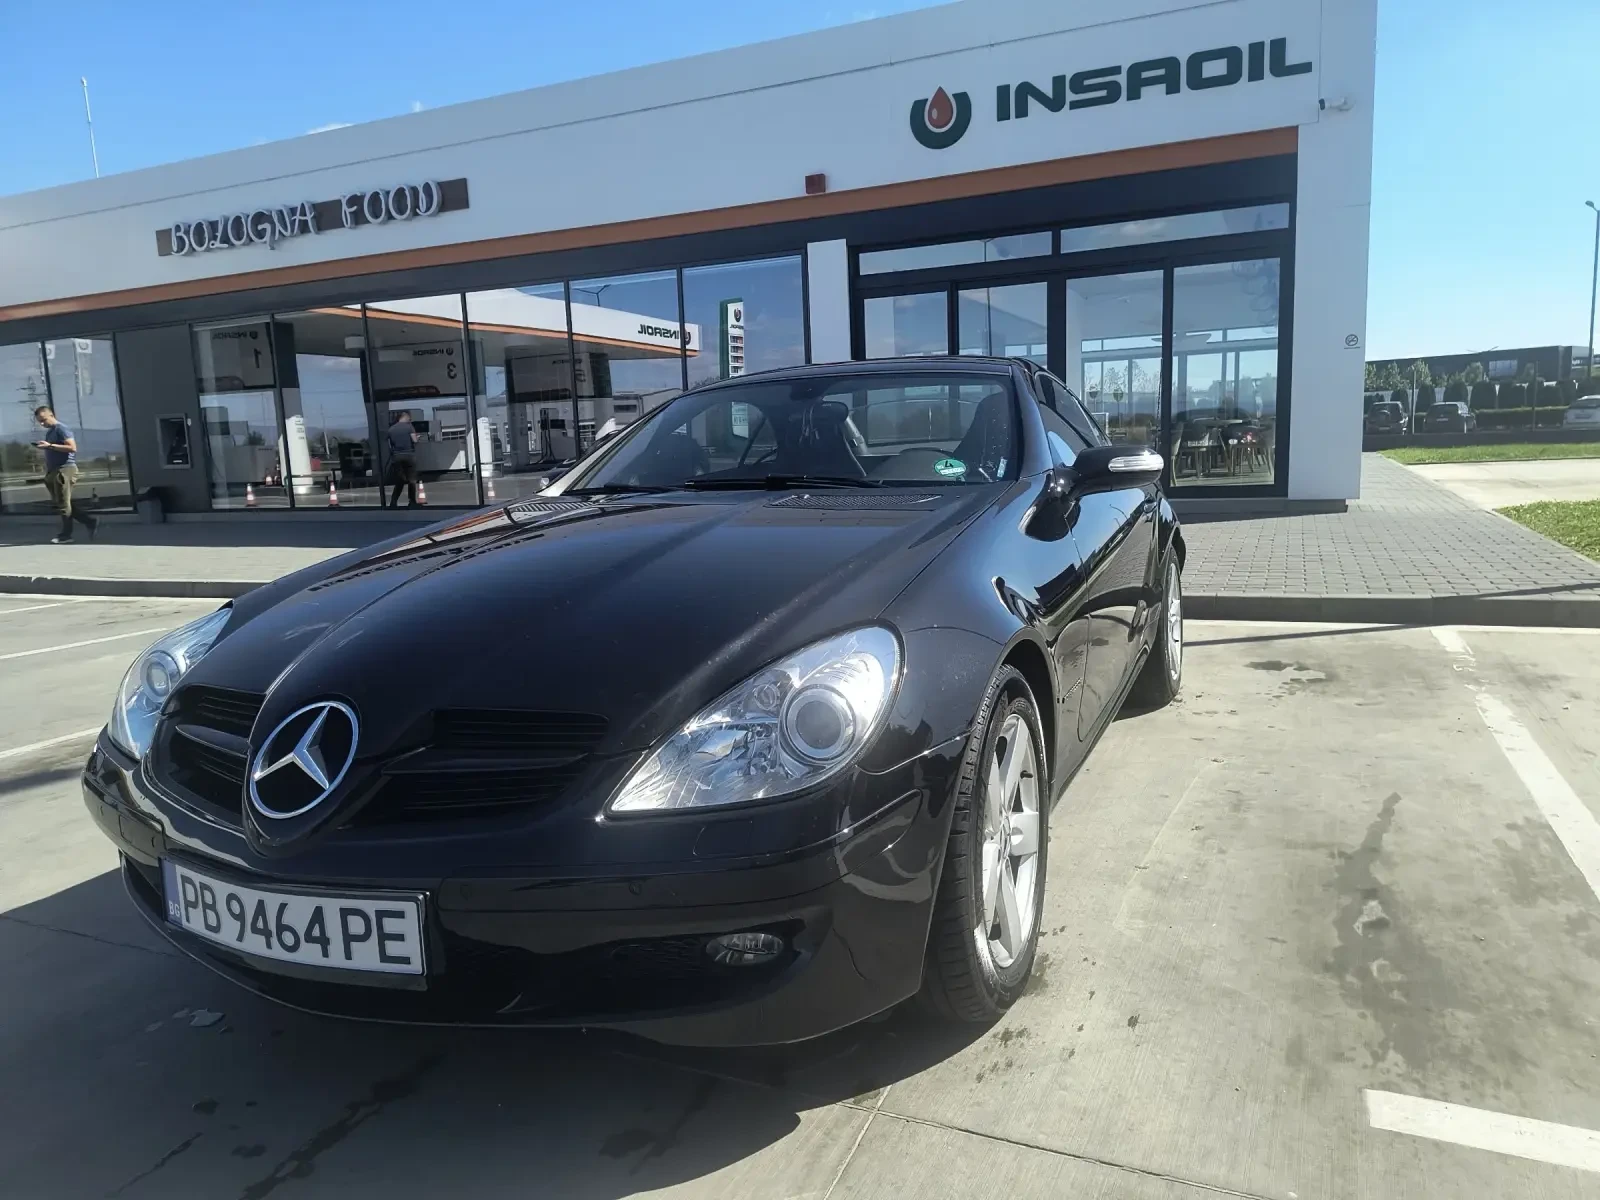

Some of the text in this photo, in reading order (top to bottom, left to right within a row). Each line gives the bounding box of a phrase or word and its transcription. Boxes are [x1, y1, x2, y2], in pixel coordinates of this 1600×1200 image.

[997, 37, 1312, 122] INSAOIL
[171, 180, 442, 256] BOLOGNA FOOD
[168, 900, 181, 917] BG
